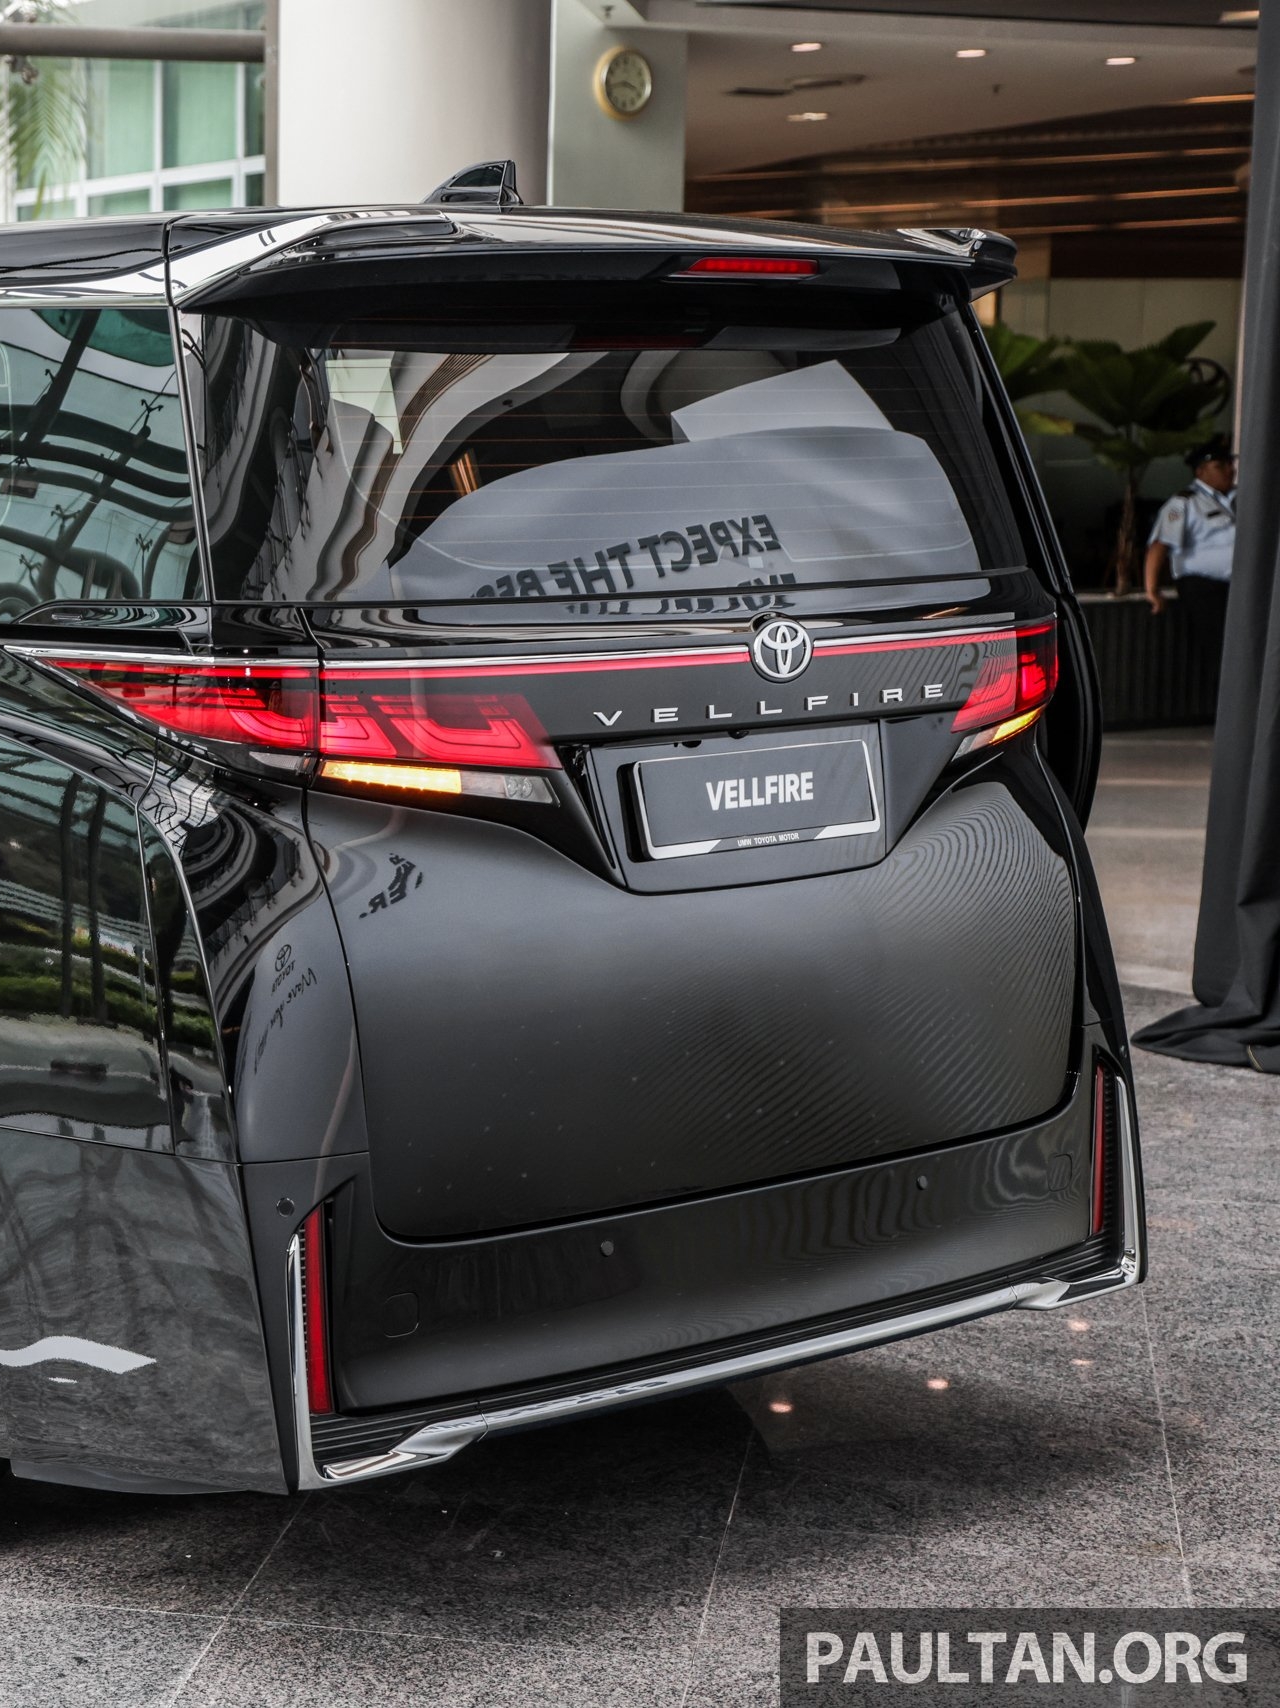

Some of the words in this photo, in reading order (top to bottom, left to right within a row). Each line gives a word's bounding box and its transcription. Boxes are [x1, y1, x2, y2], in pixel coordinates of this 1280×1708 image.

[593, 683, 944, 727] VELLFIRE
[705, 771, 814, 811] VELLFIRE
[737, 838, 752, 847] UMW
[754, 835, 777, 845] TOYOTA
[778, 832, 800, 841] MOTOR
